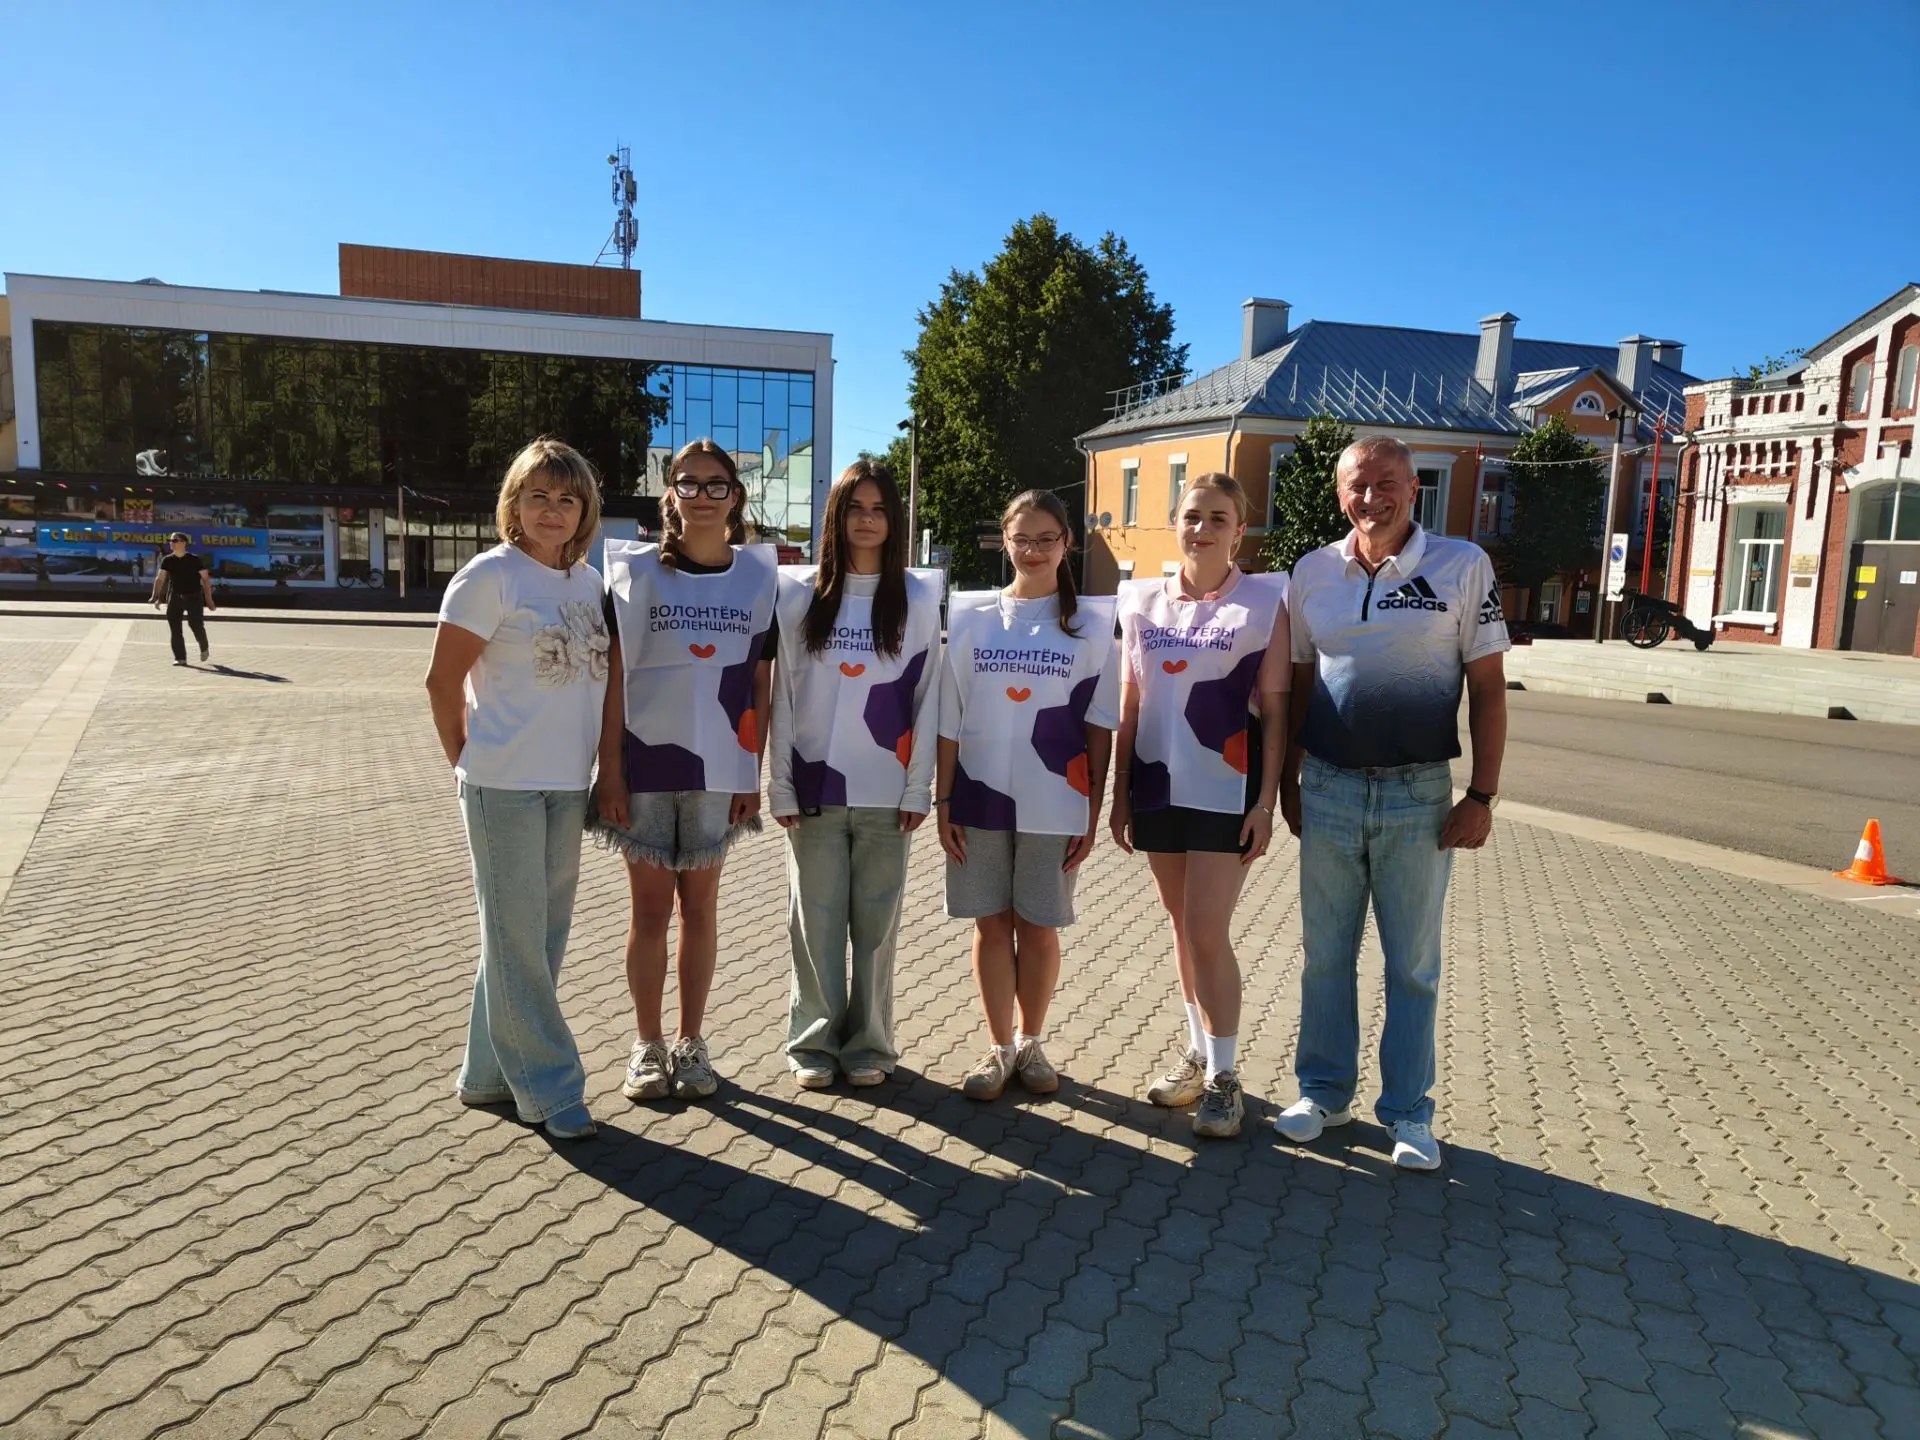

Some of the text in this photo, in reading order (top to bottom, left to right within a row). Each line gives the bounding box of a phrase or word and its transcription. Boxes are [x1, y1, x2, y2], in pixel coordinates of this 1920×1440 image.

[1376, 596, 1448, 612] adidas
[649, 605, 752, 622] ВОЛОНТЁРЫ
[650, 619, 750, 635] СМОЛЕНЩИНЫ
[973, 648, 1075, 666] ВОЛОНТЁРЫ
[974, 662, 1071, 679] СМОЛЕНЩИНЫ
